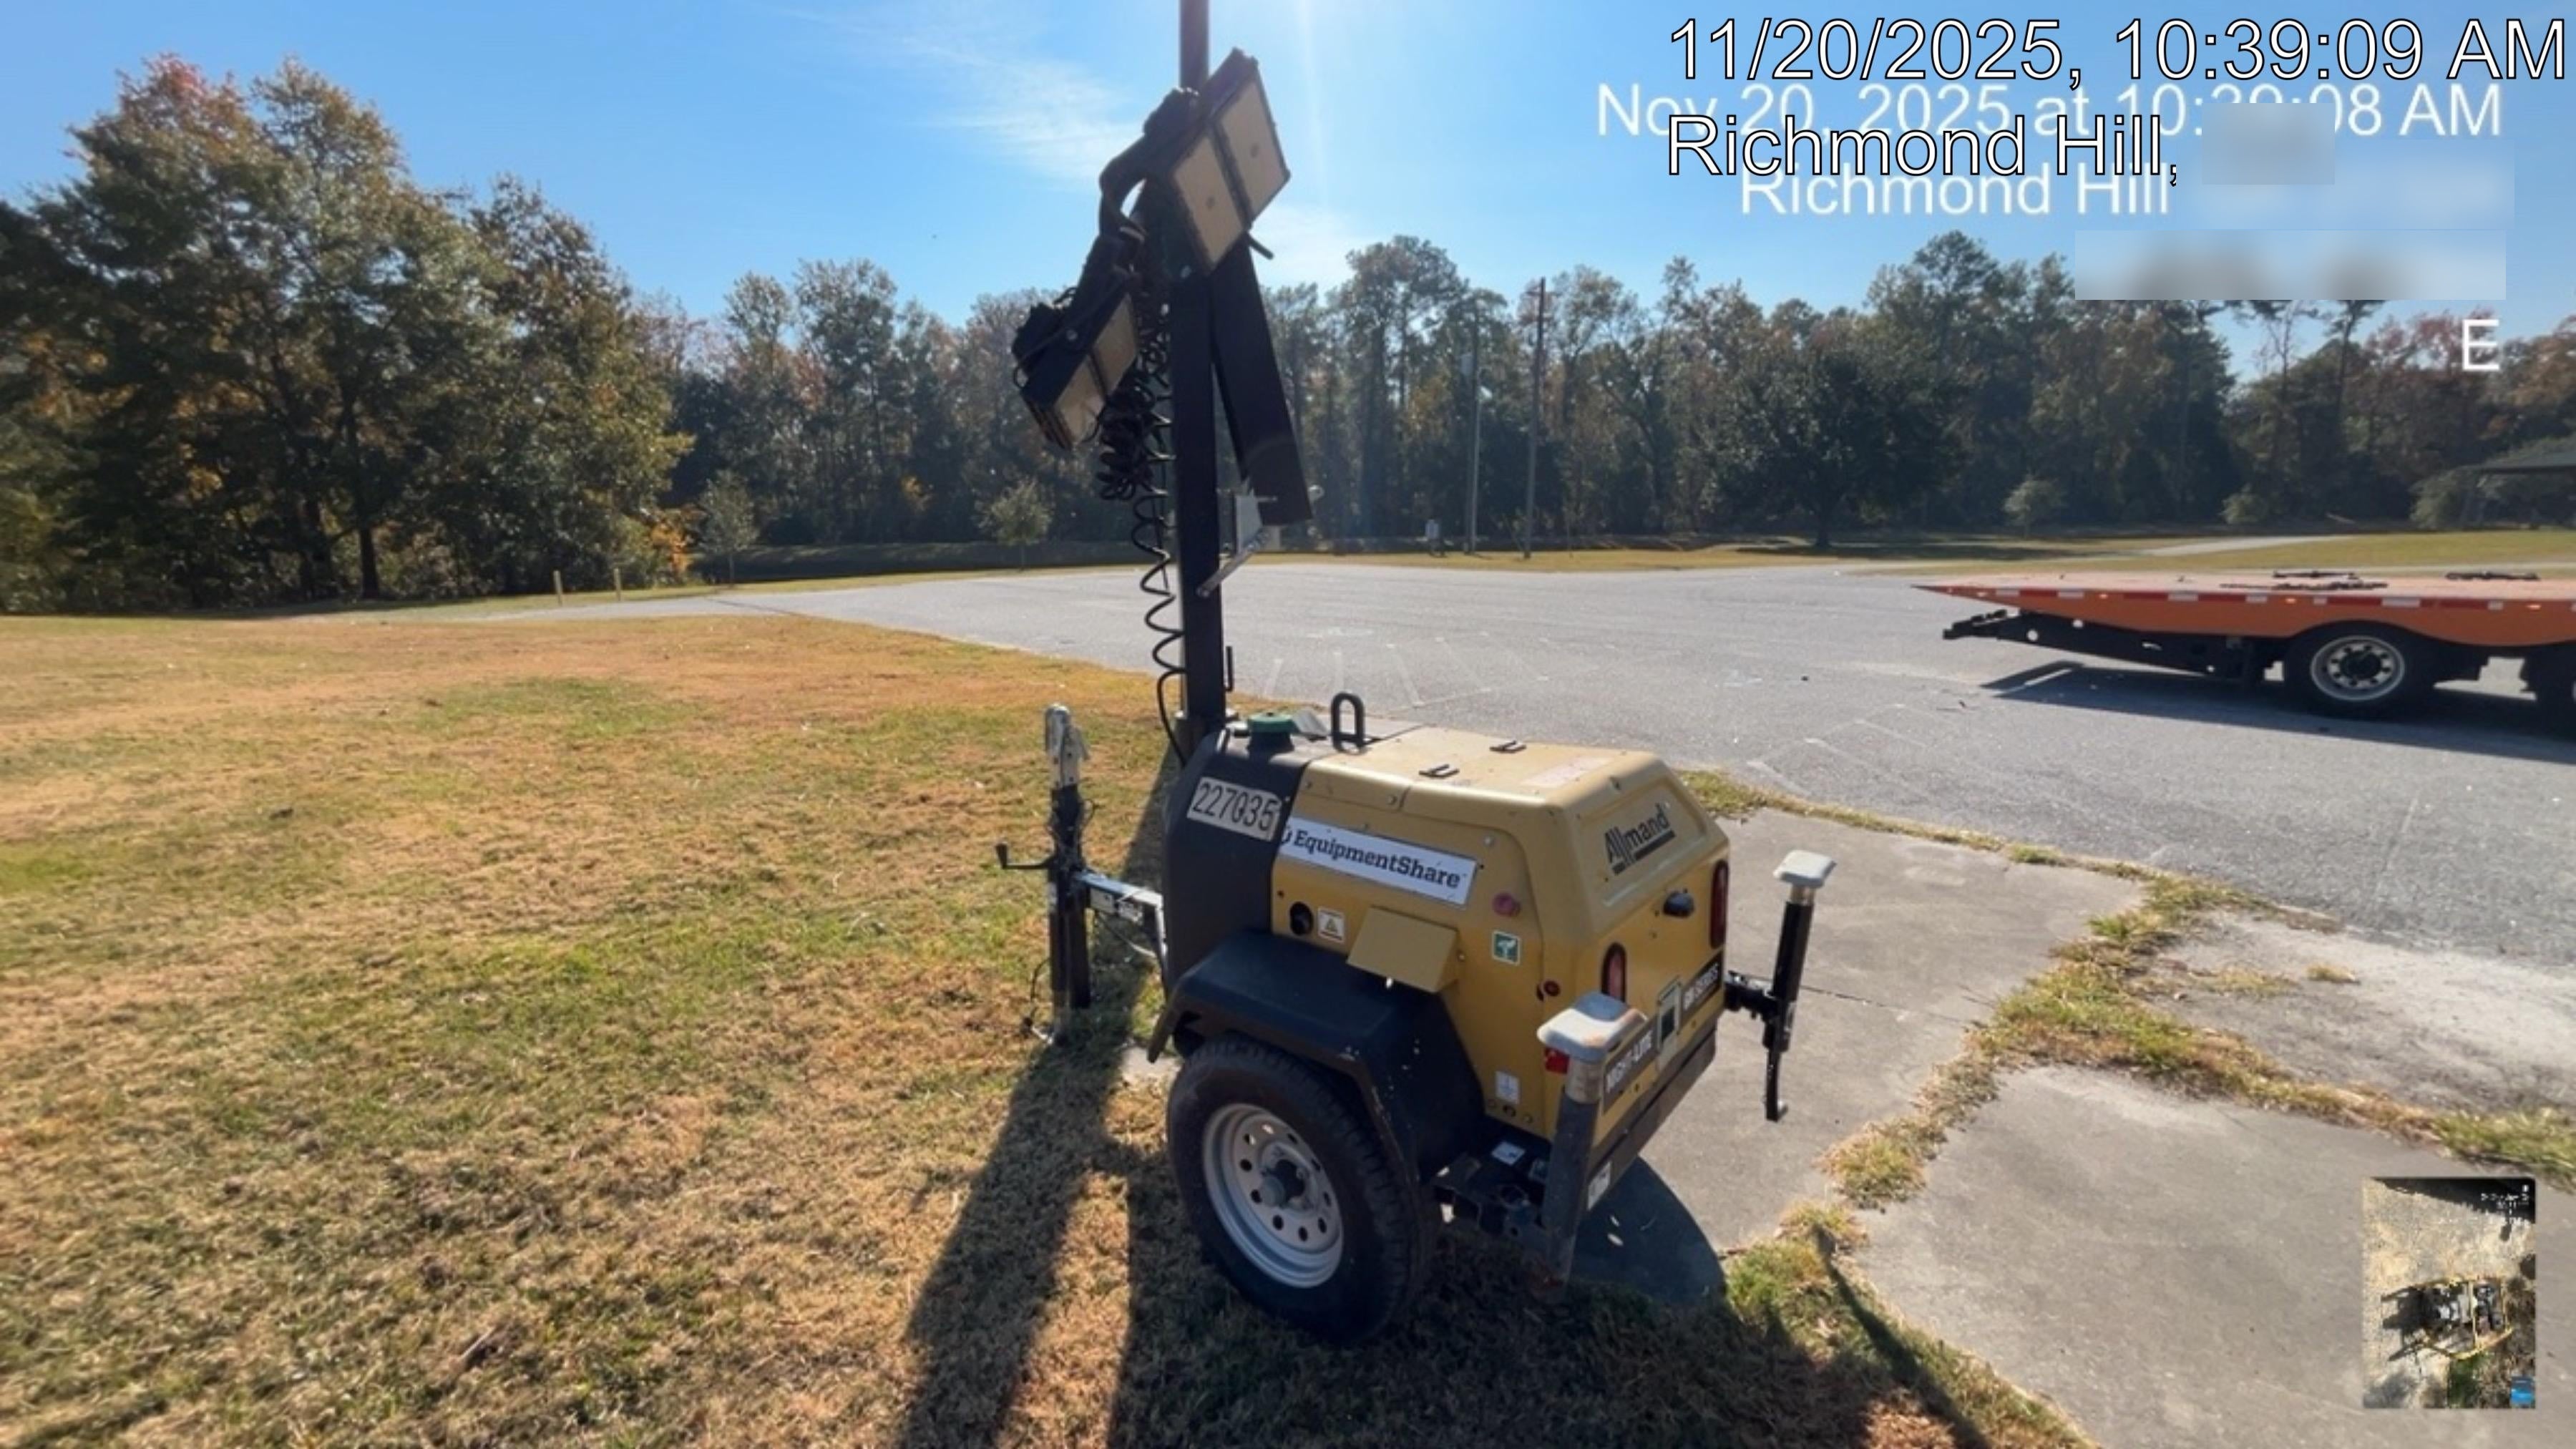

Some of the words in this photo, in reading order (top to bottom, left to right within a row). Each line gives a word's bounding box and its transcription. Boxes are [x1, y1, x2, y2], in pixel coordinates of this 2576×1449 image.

[1192, 781, 1279, 831] 227035
[1604, 802, 1671, 867] Allmand
[1293, 829, 1461, 889] EquipmentShare
